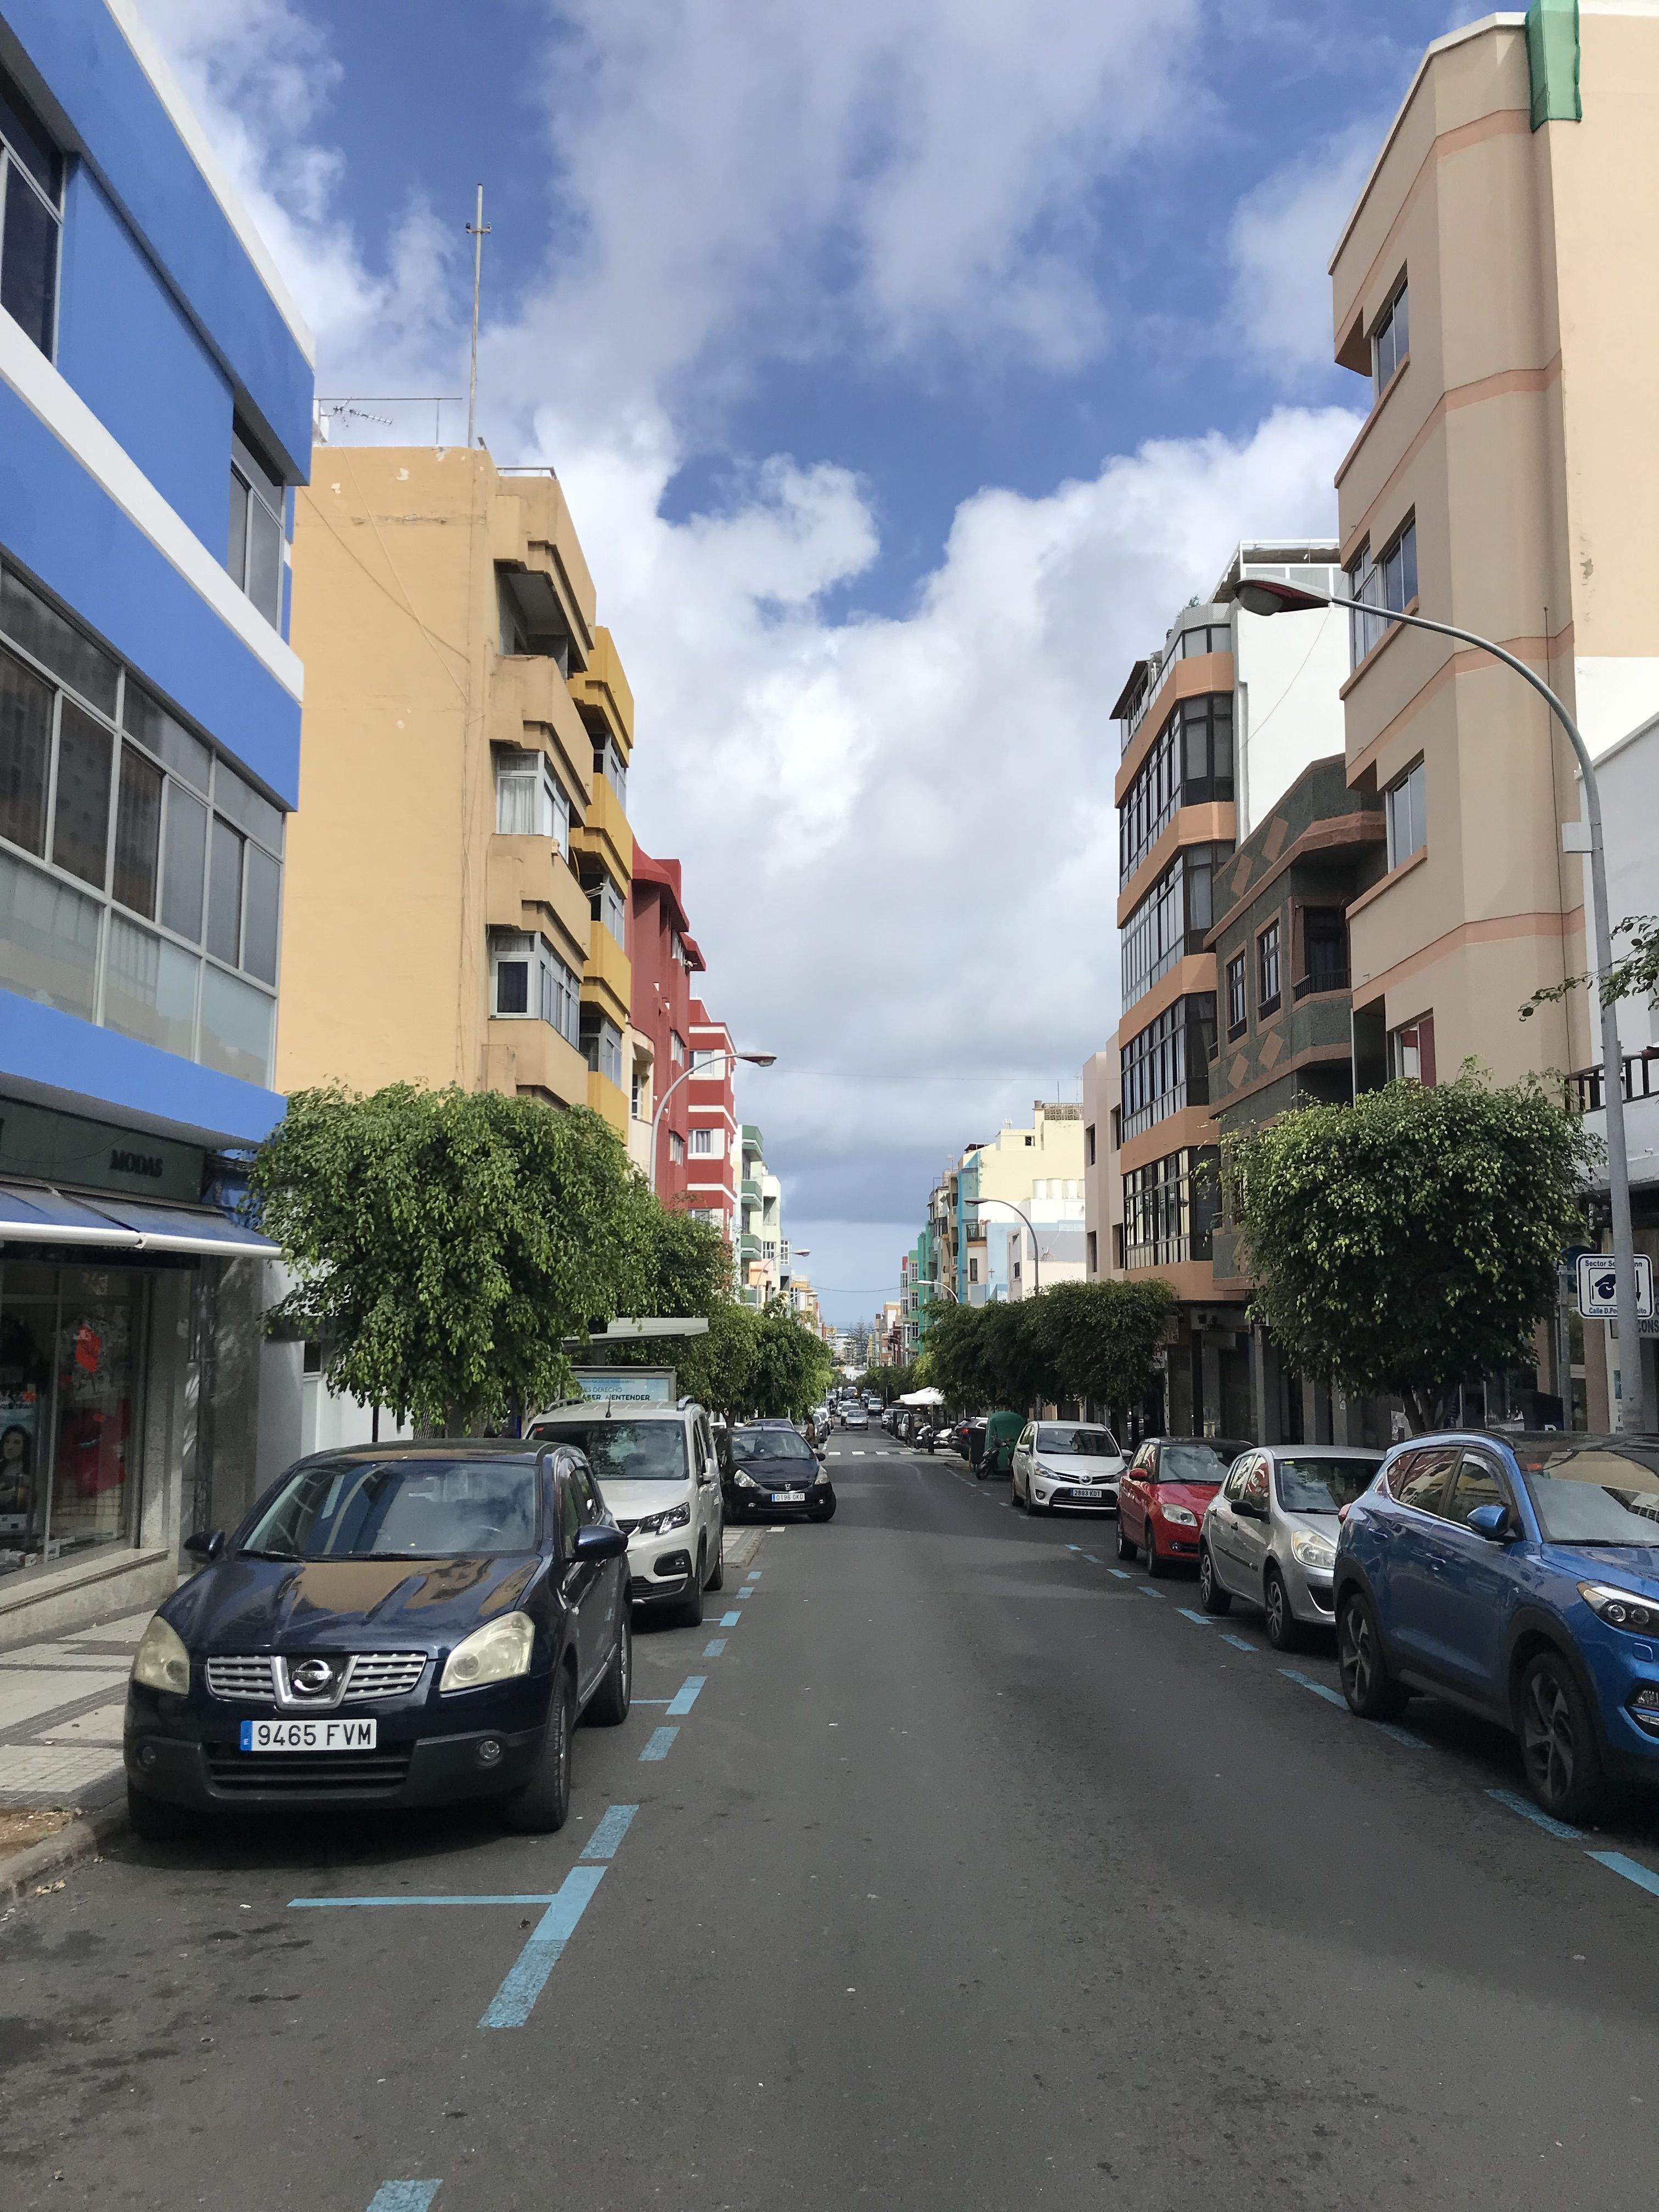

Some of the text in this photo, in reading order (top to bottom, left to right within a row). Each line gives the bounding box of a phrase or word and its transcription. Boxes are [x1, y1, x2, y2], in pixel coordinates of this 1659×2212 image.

[110, 1150, 163, 1178] MODAS
[258, 1724, 317, 1746] 9465
[326, 1723, 371, 1746] FVM
